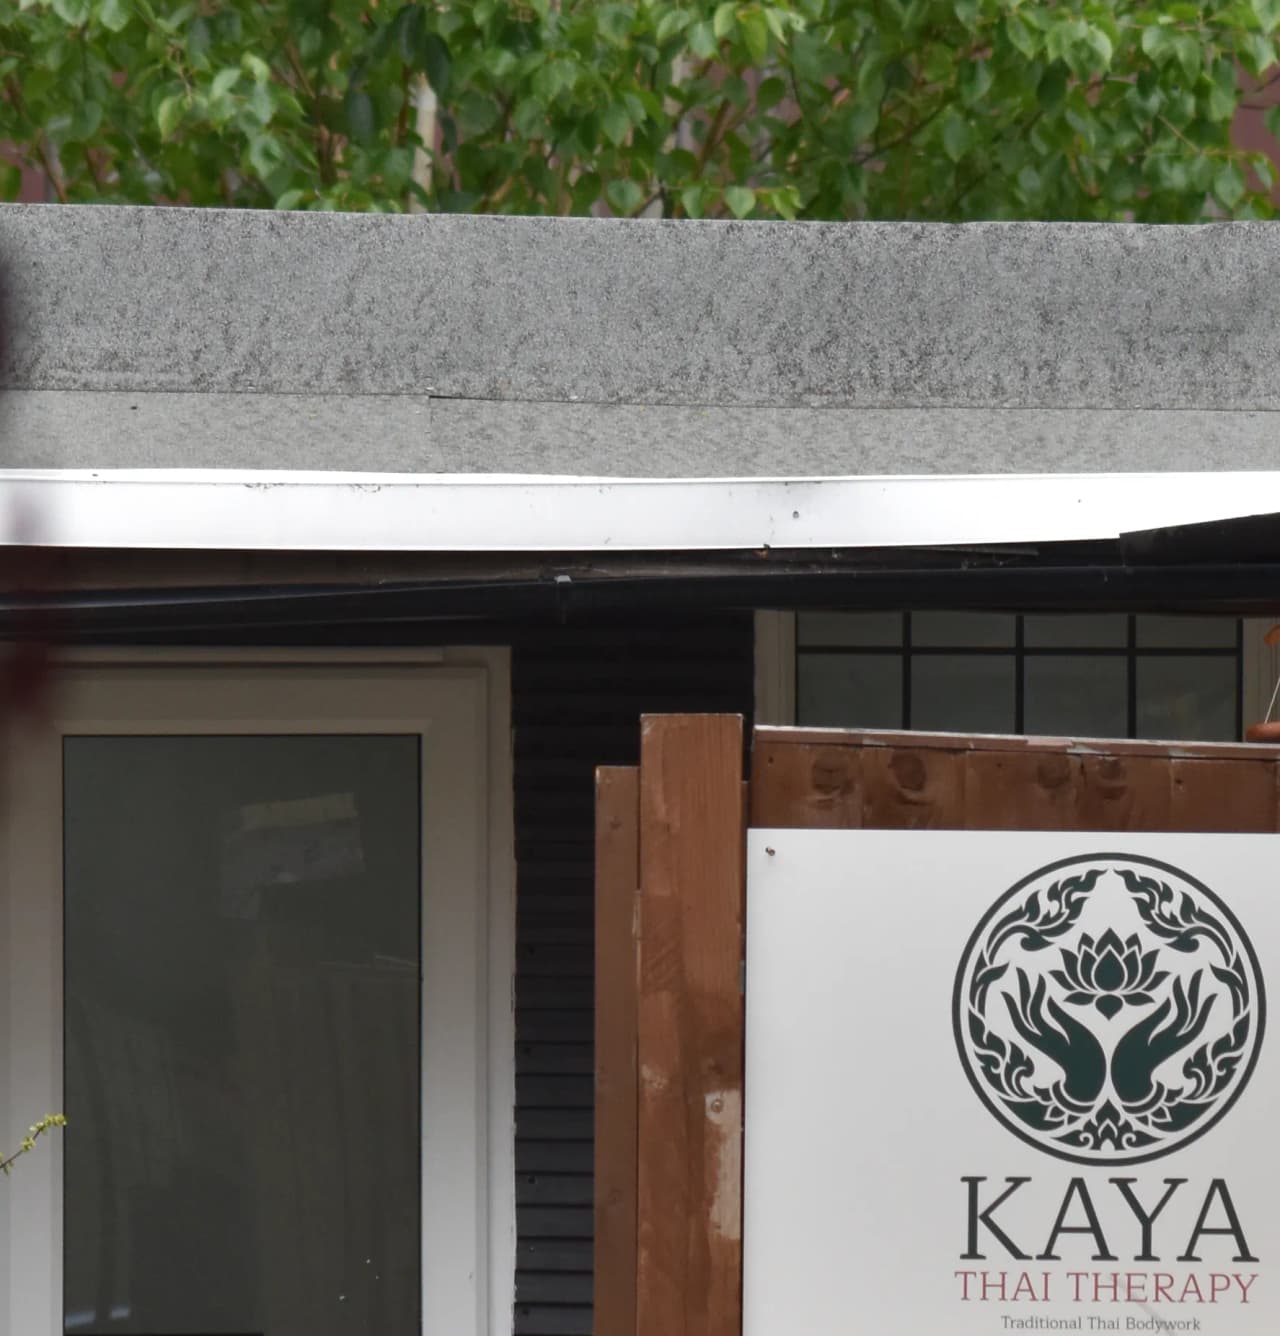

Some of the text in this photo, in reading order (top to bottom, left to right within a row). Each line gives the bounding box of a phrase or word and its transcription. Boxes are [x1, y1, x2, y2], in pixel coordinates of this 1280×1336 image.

[959, 1176, 1260, 1263] KAYA
[954, 1271, 1259, 1304] THAI THERAPY
[1000, 1315, 1201, 1335] Traditional Thai Bodywork
